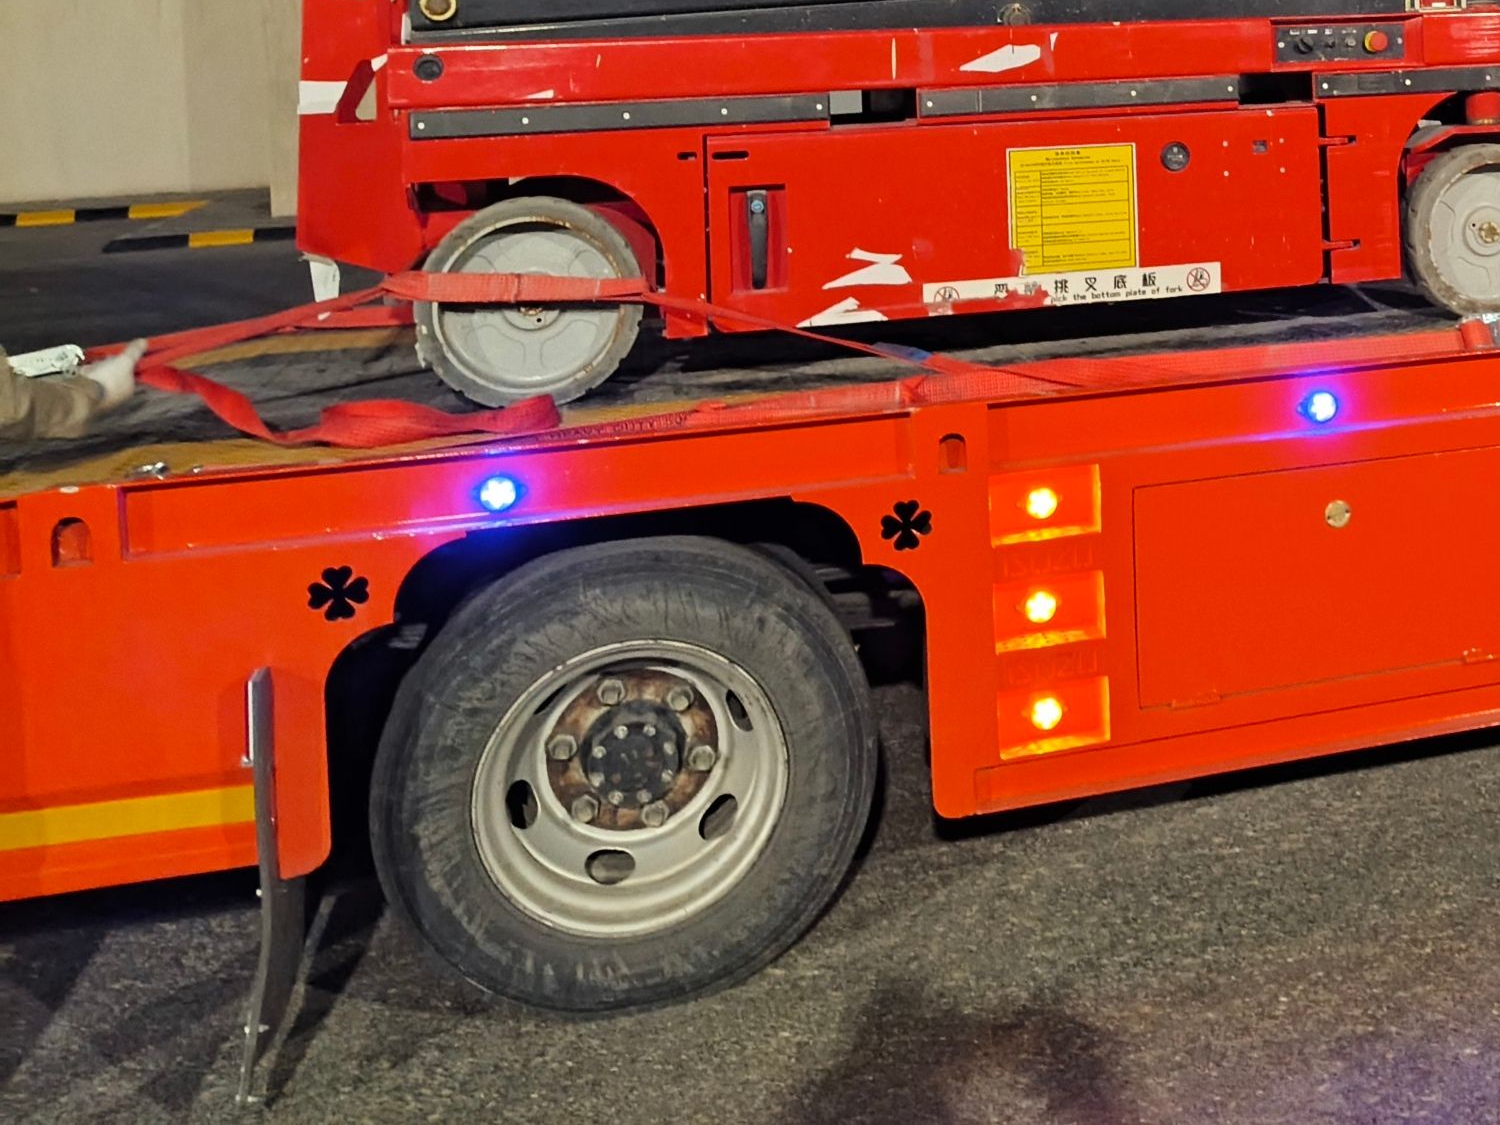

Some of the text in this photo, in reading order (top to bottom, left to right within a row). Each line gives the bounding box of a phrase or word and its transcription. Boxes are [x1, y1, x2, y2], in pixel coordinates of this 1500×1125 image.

[1073, 293, 1087, 301] the
[1091, 291, 1122, 300] bottom
[1125, 288, 1147, 298] plate
[1151, 287, 1160, 295] of
[1165, 285, 1183, 293] fork
